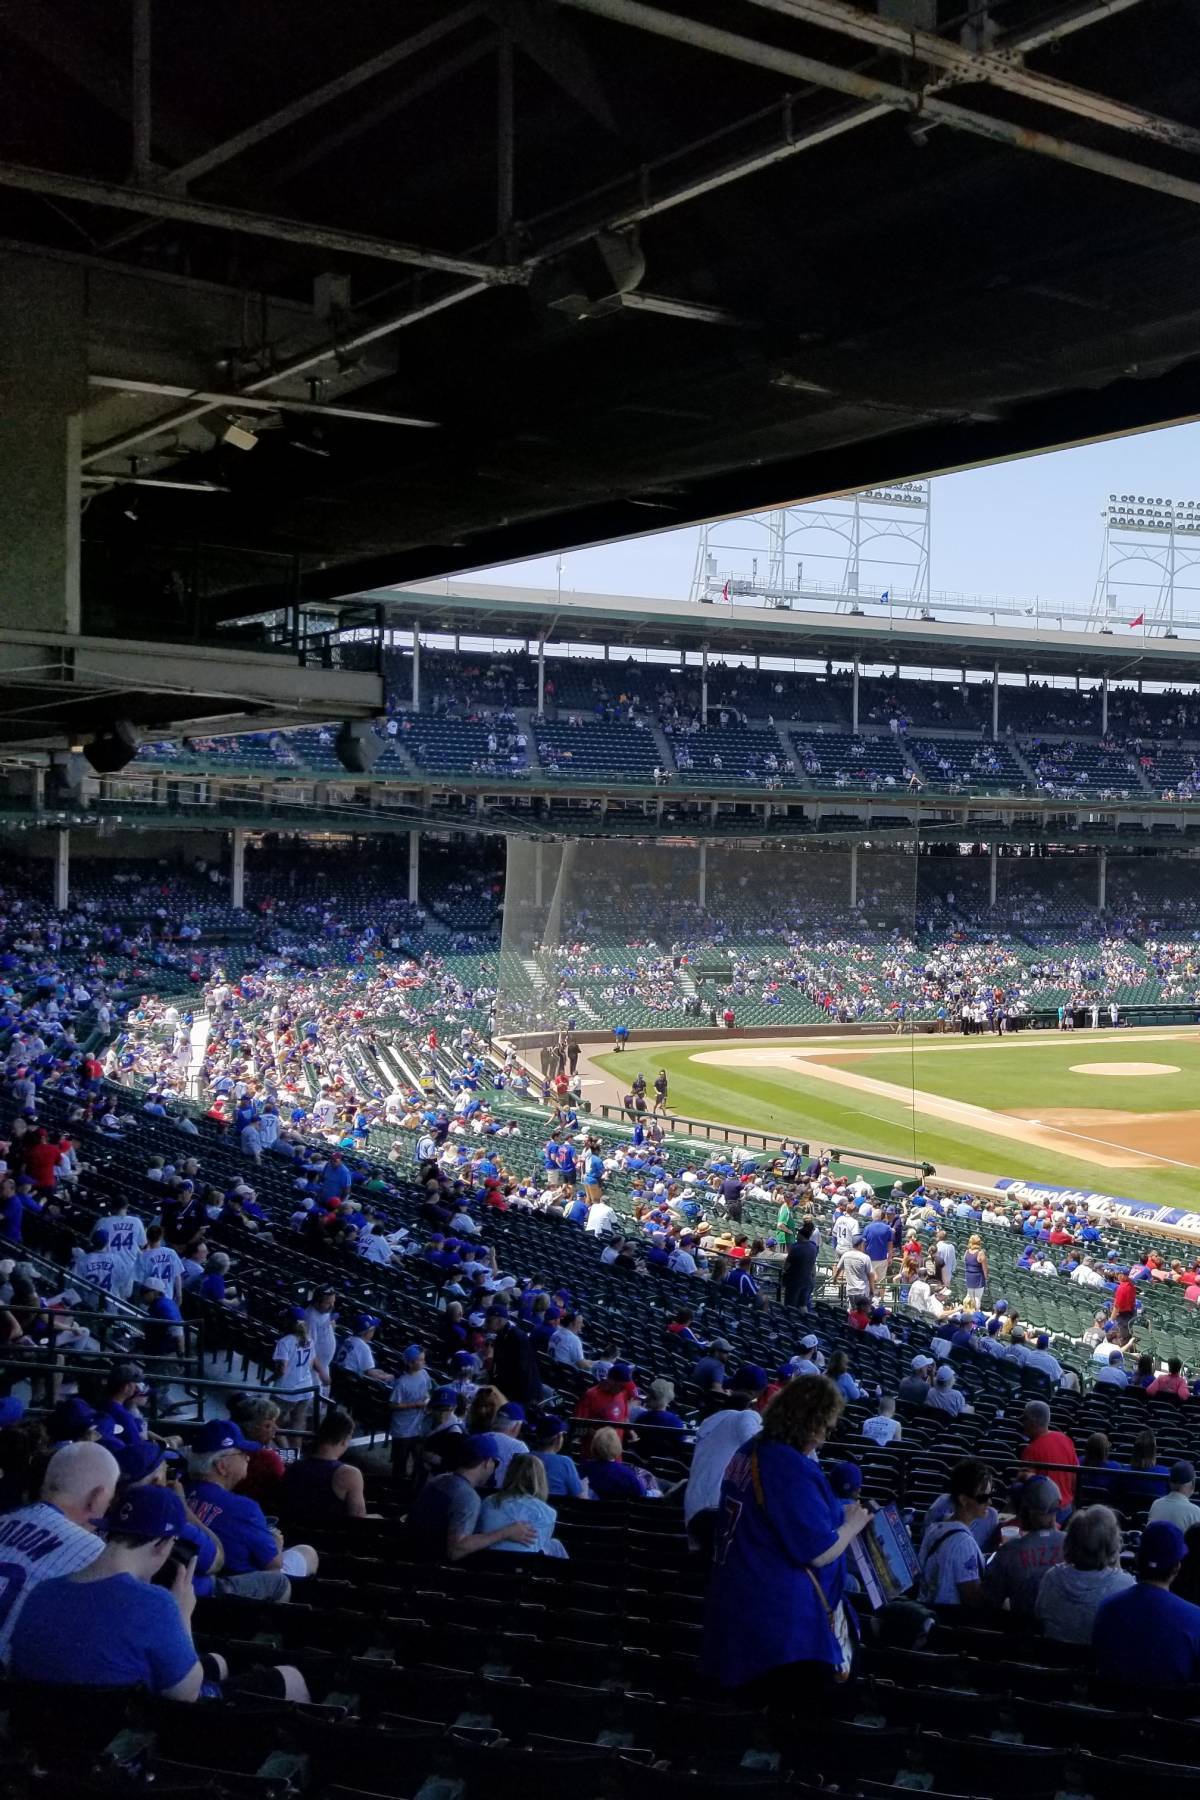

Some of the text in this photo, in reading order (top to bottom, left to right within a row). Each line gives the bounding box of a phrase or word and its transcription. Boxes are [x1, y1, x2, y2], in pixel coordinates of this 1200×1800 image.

[110, 1232, 134, 1251] 44
[87, 1261, 113, 1272] LESTER
[297, 1349, 311, 1367] 17
